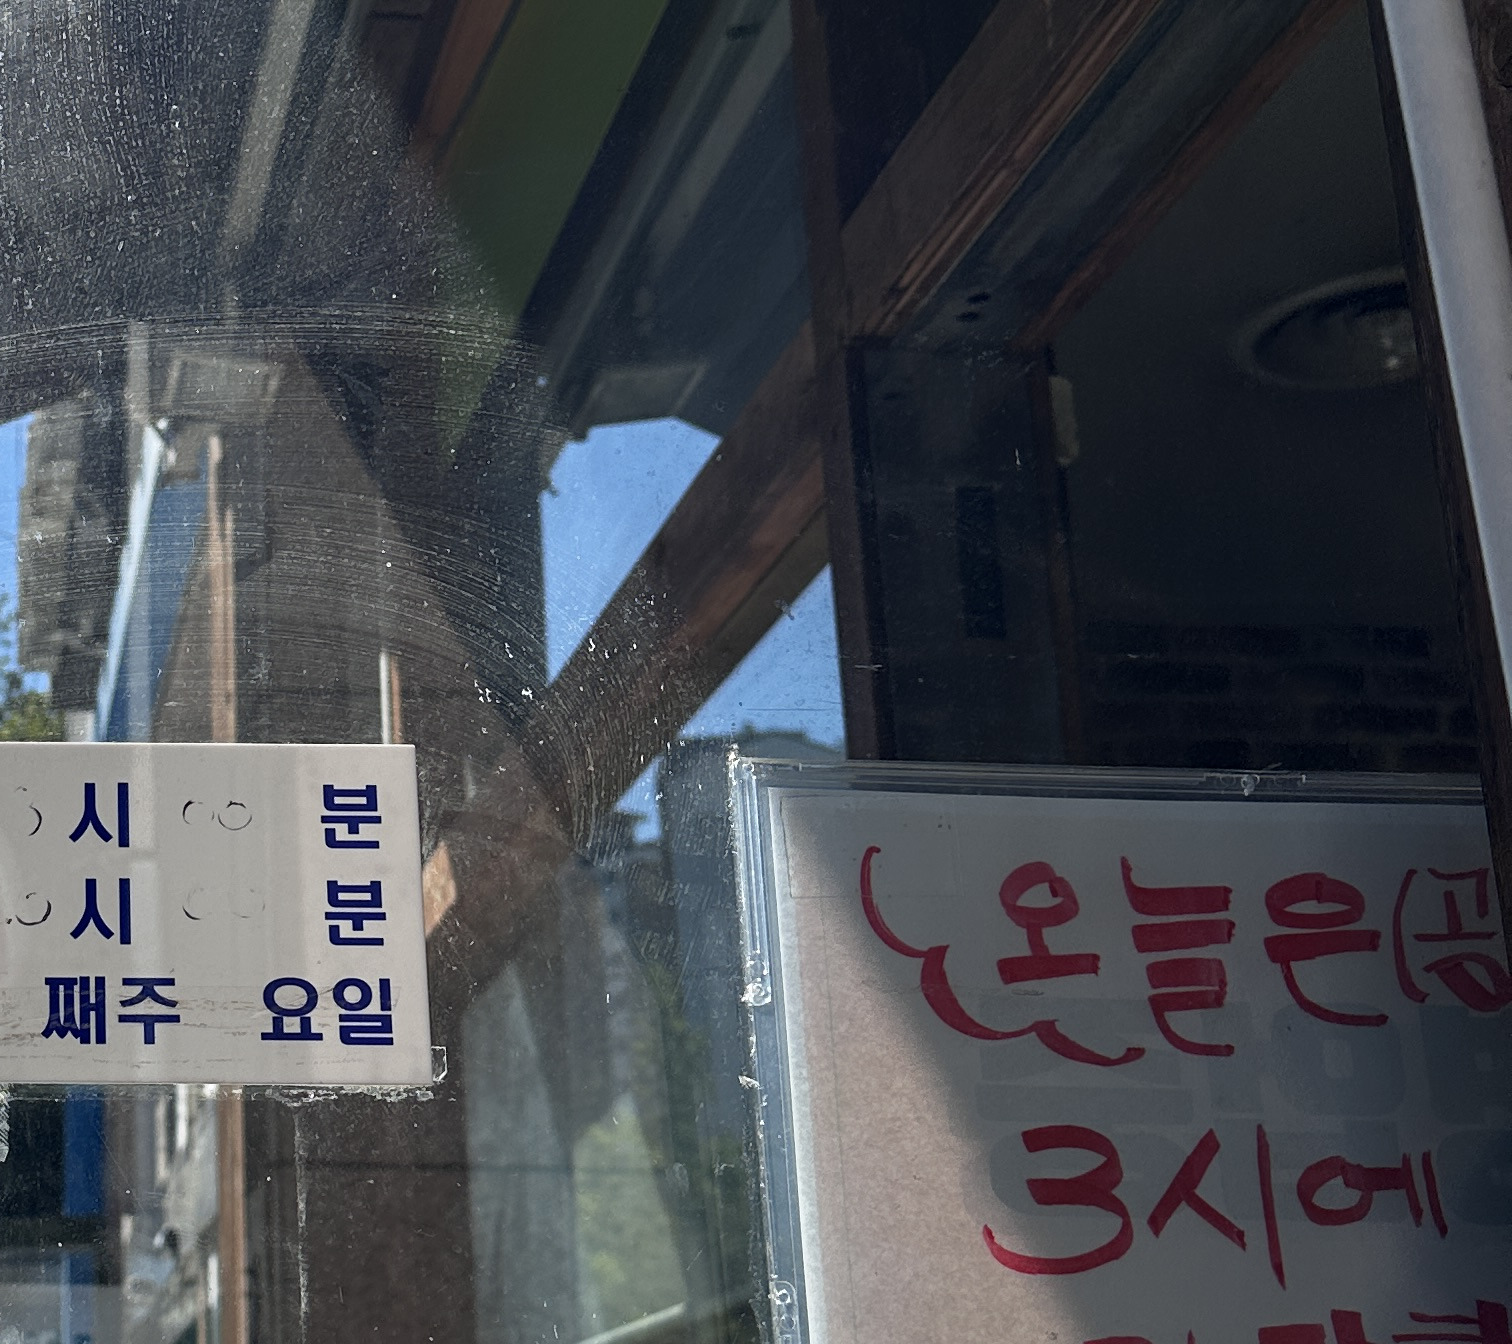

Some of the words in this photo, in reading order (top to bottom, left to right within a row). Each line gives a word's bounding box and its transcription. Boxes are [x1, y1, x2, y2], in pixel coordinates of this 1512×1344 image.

[68, 782, 130, 848] 시
[320, 784, 382, 849] 분
[69, 878, 131, 945] 시
[324, 880, 387, 947] 분
[41, 976, 181, 1046] 째주
[260, 977, 395, 1046] 요일
[982, 1123, 1449, 1291] 3시에
